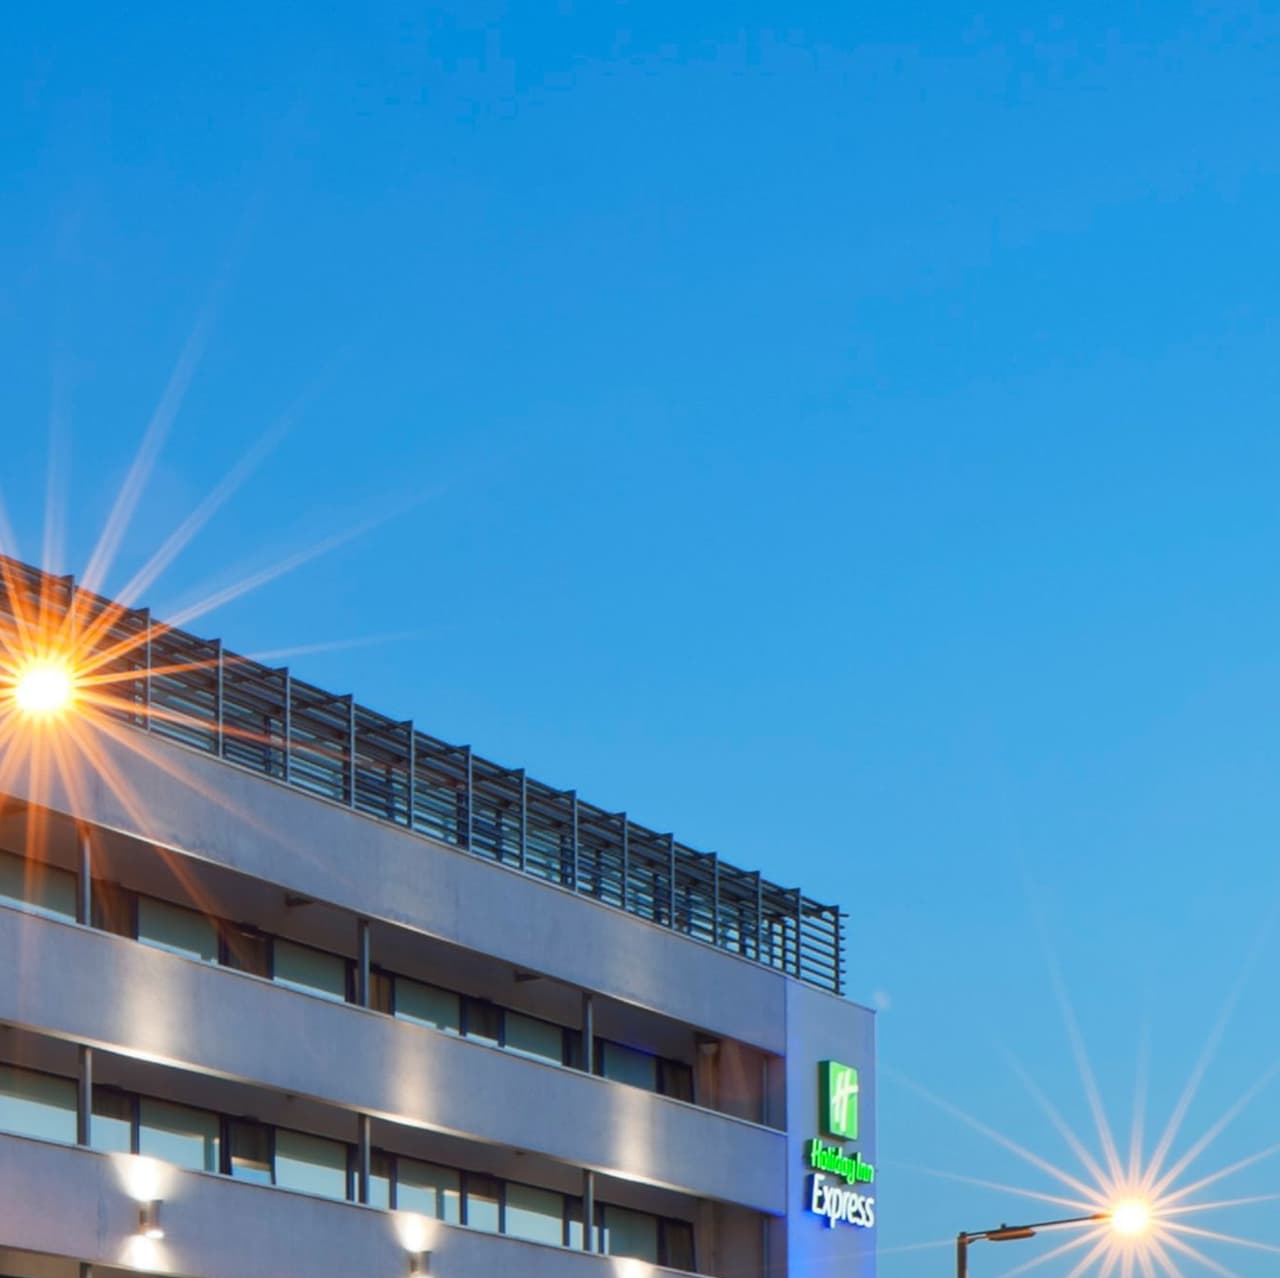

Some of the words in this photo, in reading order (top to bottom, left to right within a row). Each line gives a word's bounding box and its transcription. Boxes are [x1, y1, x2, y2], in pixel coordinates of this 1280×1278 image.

[811, 1138, 856, 1185] Holiday
[856, 1152, 874, 1183] Inn
[811, 1173, 875, 1229] Express
